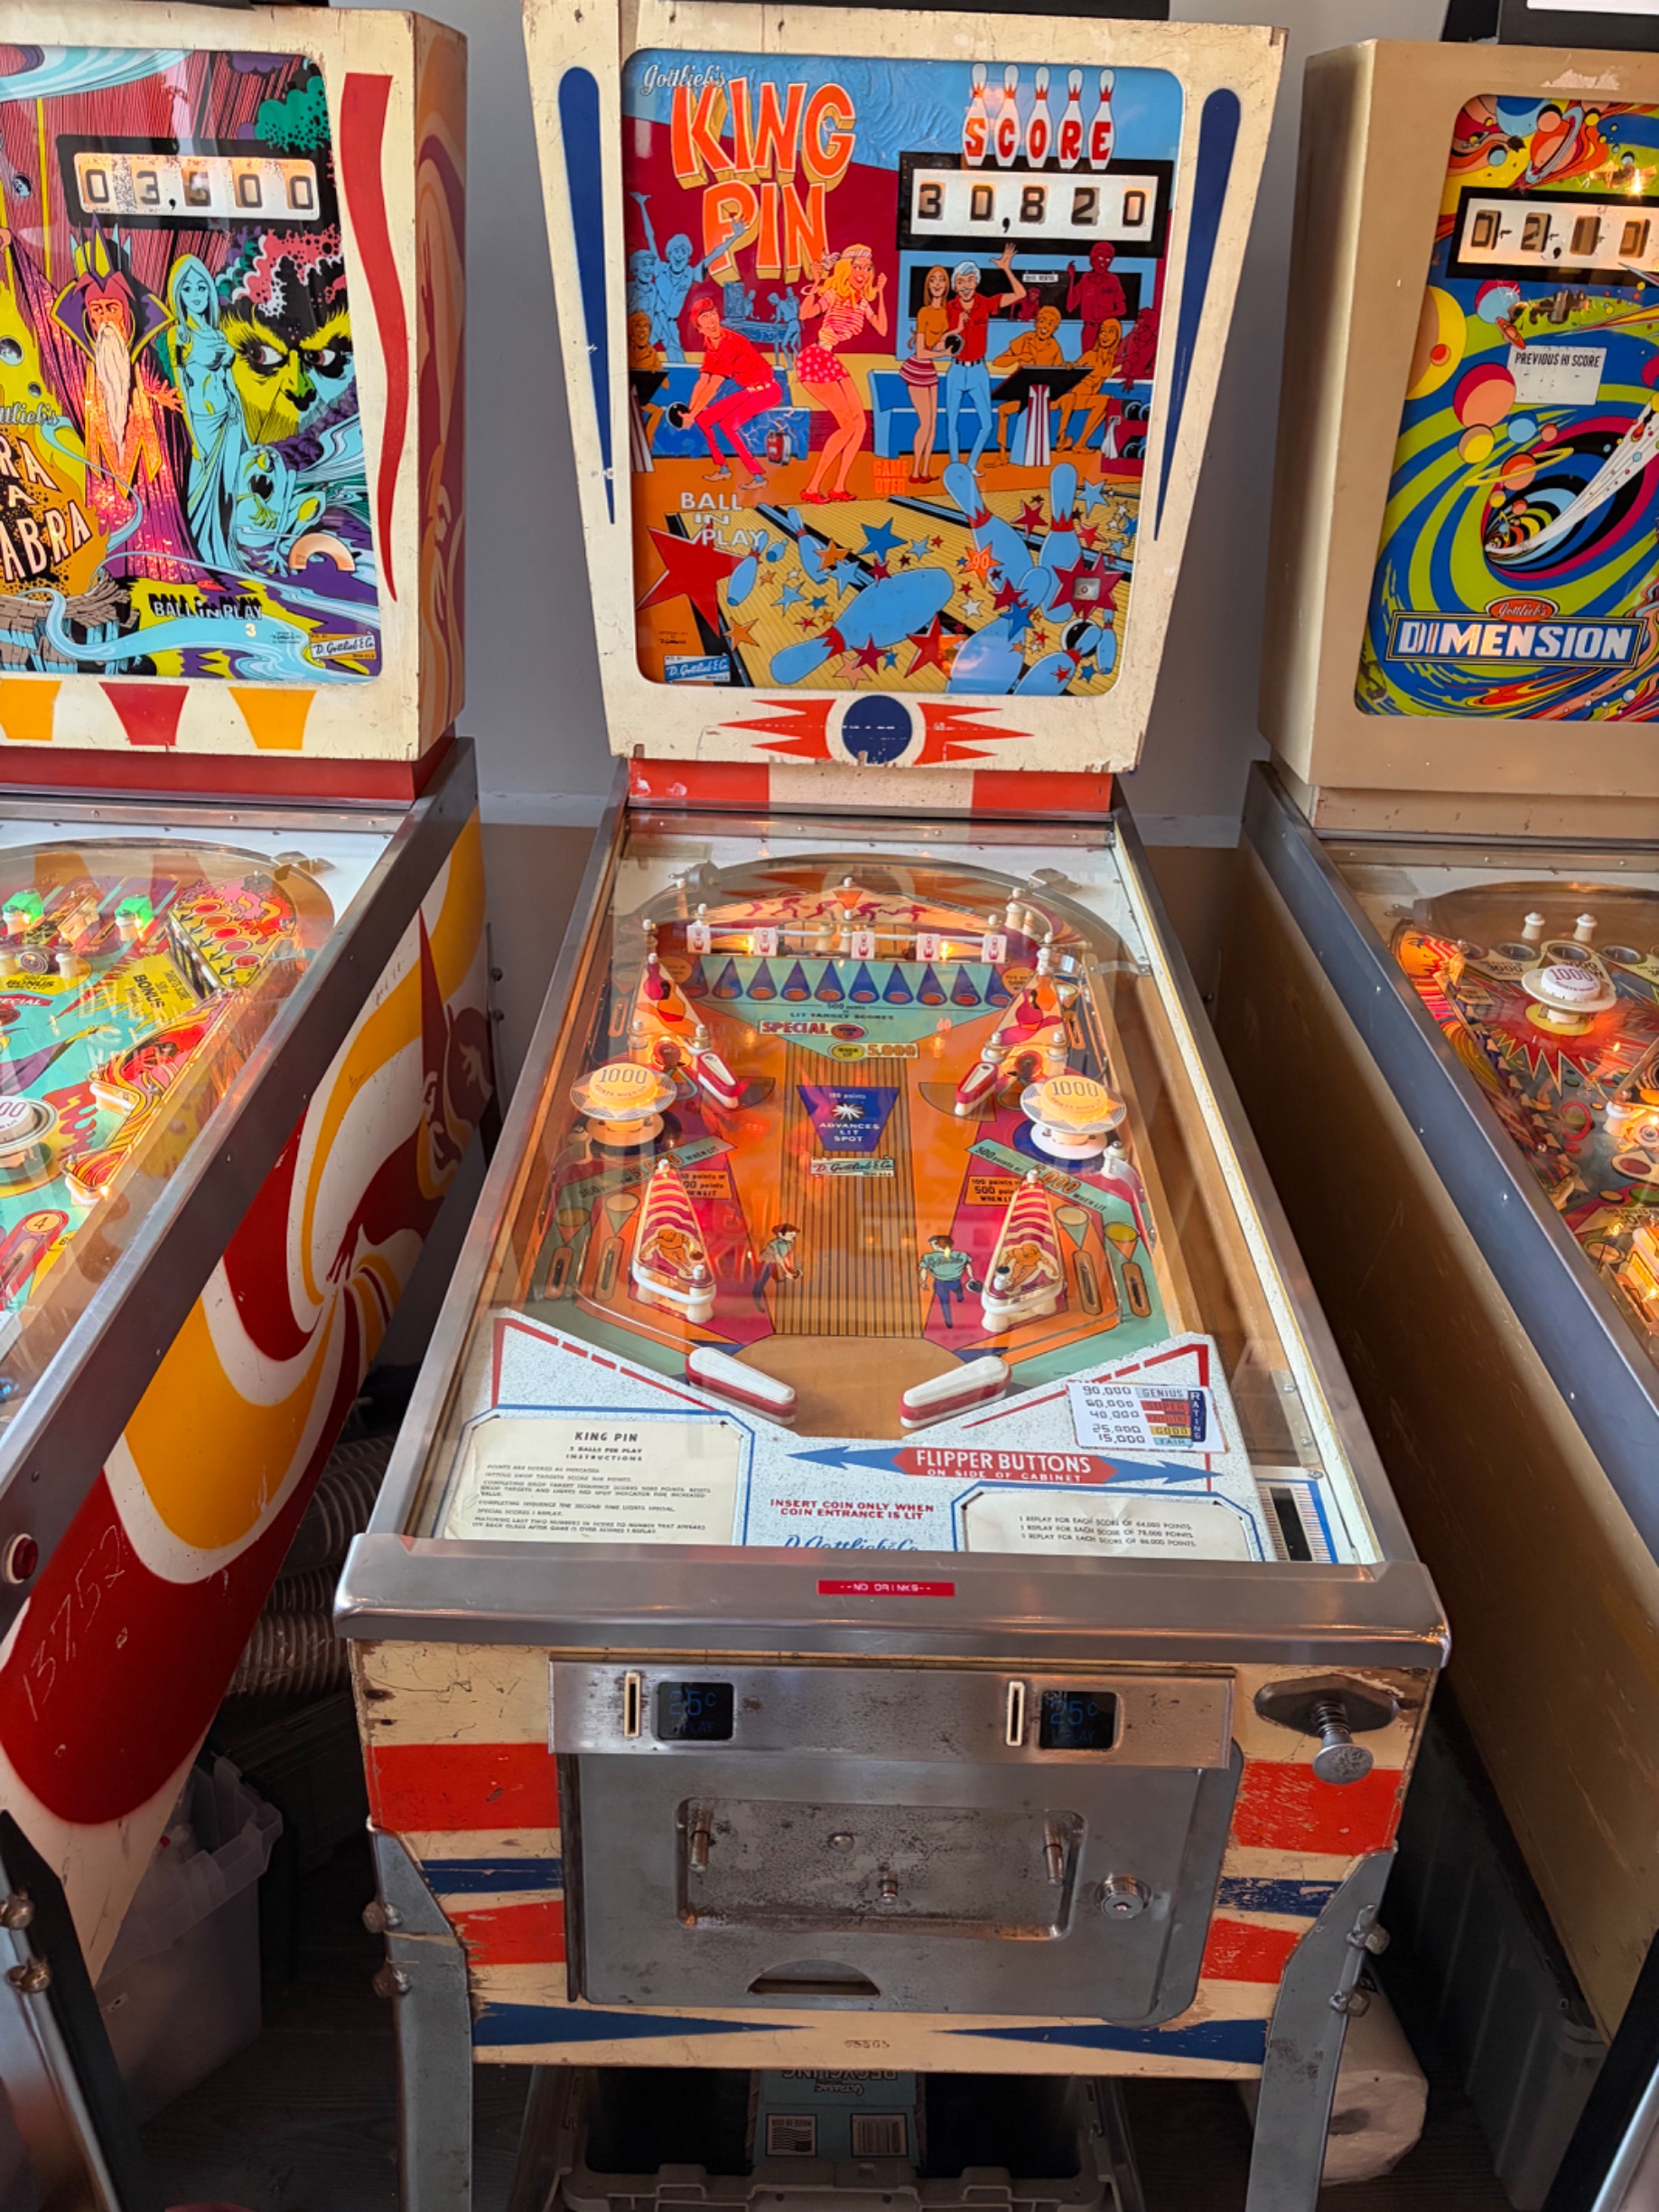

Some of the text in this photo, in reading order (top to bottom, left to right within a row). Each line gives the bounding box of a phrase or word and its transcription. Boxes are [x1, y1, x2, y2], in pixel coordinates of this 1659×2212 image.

[639, 64, 725, 96] Gottlieb's
[670, 77, 856, 186] KING
[964, 117, 1112, 161] SCORE
[918, 183, 1146, 234] 30,820
[703, 180, 829, 280] PIN
[1515, 351, 1601, 369] PREVIOUS HI SCORE
[872, 460, 909, 477] GAME
[874, 478, 906, 494] OVER
[680, 491, 743, 511] BALL
[694, 513, 730, 526] IN
[702, 529, 766, 547] PLAY
[973, 554, 990, 570] 90
[152, 597, 192, 618] BALL
[221, 600, 263, 621] PLAY
[245, 622, 256, 638] 3
[1398, 621, 1633, 660] DIMENSION
[761, 1021, 829, 1035] SPECIAL
[867, 1044, 917, 1057] 5,000
[599, 1068, 648, 1085] 1000
[1051, 1081, 1100, 1097] 1000
[974, 1186, 996, 1195] 500
[33, 1216, 49, 1229] 4
[1082, 1386, 1185, 1398] 90,000 GENIUS
[1147, 1402, 1186, 1412] SUPER
[1089, 1410, 1140, 1421] 40,000
[1190, 1391, 1201, 1440] RATING
[574, 1432, 638, 1442] KING PIN
[1098, 1433, 1146, 1444] 15,000
[1155, 1426, 1188, 1436] GOOD
[565, 1453, 642, 1461] INSTRUCTIONS
[916, 1449, 1092, 1473] FLIPPER BUTTONS
[927, 1469, 1082, 1482] ON SIDE OF CABINET
[770, 1498, 935, 1513] INSERT COIN ONLY WHEN
[780, 1507, 924, 1520] COIN ENTRANCE IS LIT
